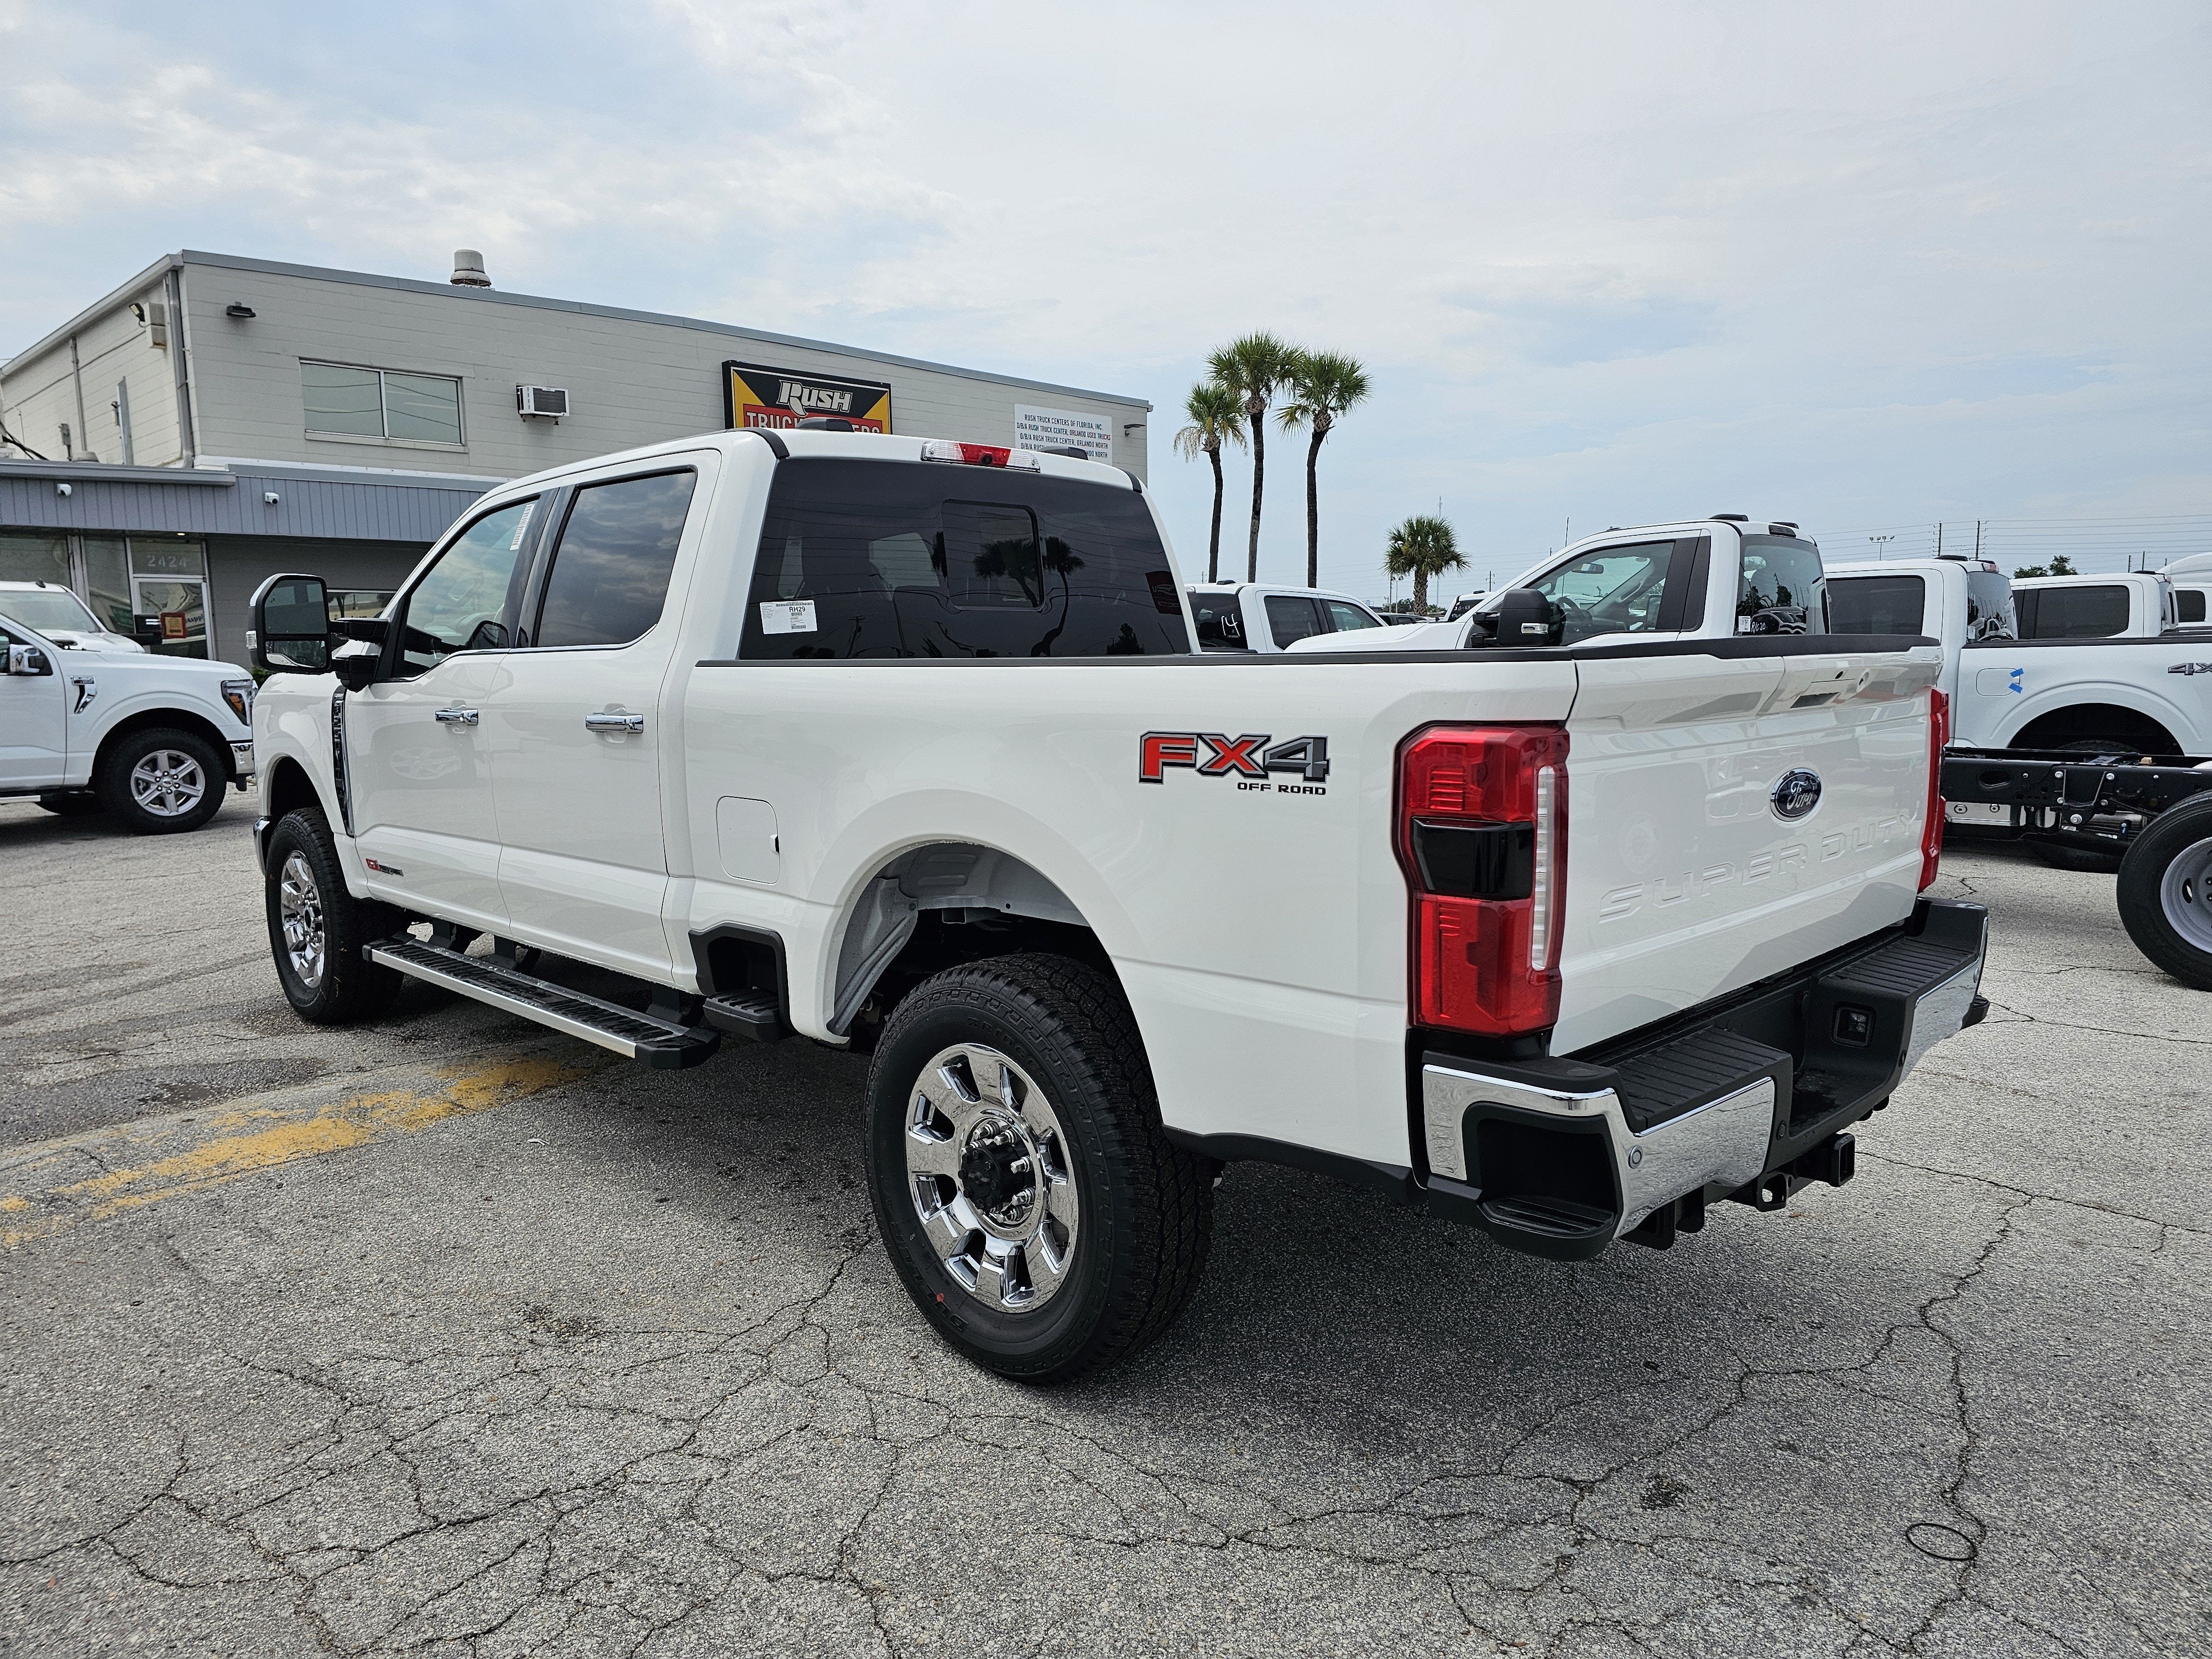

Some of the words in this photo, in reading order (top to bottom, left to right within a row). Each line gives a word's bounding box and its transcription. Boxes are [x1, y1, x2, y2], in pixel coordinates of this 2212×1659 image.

[1040, 425, 1053, 434] TRUCK
[1070, 429, 1086, 437] ORLANDO
[1051, 418, 1070, 426] CENTERS
[1076, 421, 1094, 430] FLORIDA,
[147, 554, 187, 567] 2424
[1220, 613, 1241, 637] 14
[1139, 730, 1331, 785] FX4
[1237, 782, 1271, 792] OFF
[1277, 784, 1326, 795] ROAD
[1787, 781, 1813, 810] Ford
[1599, 843, 1808, 924] SUPER
[1820, 810, 1918, 863] DUTY
